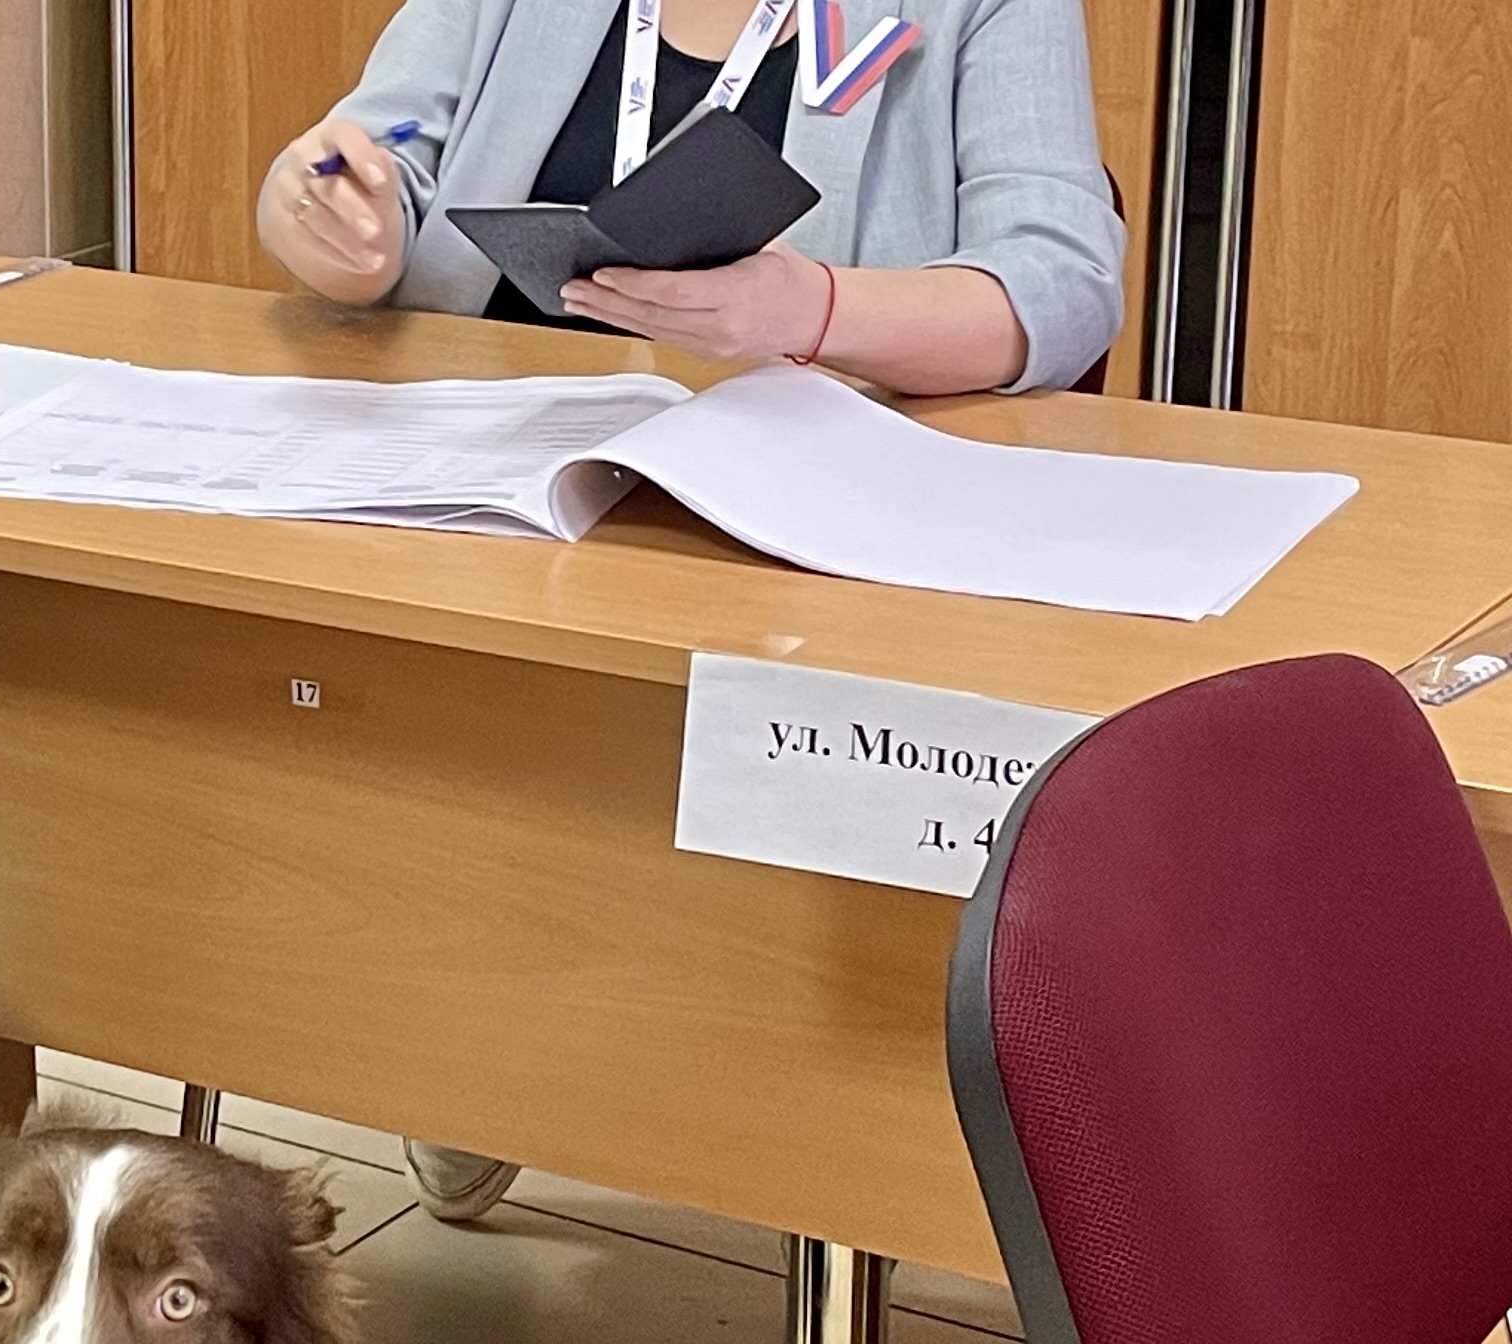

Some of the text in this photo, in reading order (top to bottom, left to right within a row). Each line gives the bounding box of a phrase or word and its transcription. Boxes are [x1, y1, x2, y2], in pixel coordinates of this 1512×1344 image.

[296, 681, 318, 704] 17
[767, 720, 1037, 790] ул. Молоде
[918, 817, 958, 851] д.
